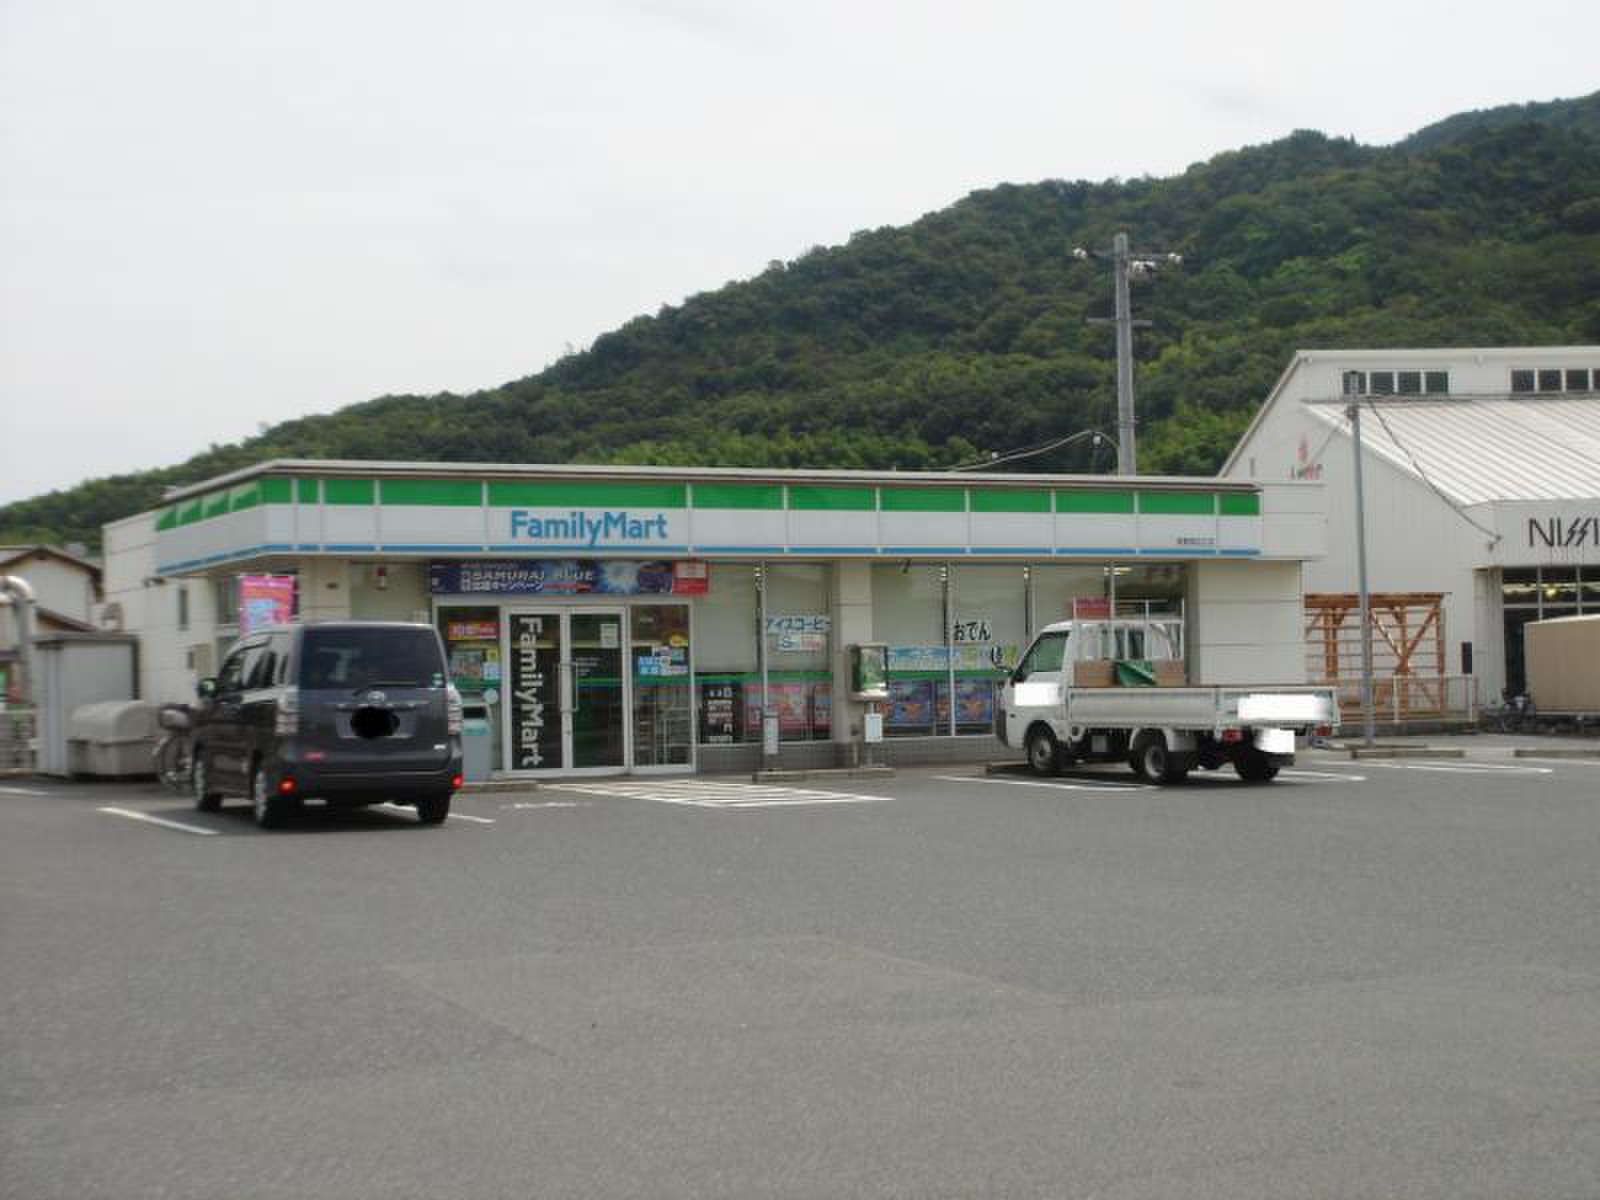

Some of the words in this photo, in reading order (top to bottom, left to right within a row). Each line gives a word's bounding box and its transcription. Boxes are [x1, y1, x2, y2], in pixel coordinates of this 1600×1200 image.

[511, 510, 668, 545] FamilyMart
[953, 620, 991, 641] おでん
[514, 617, 544, 767] FamilyMart
